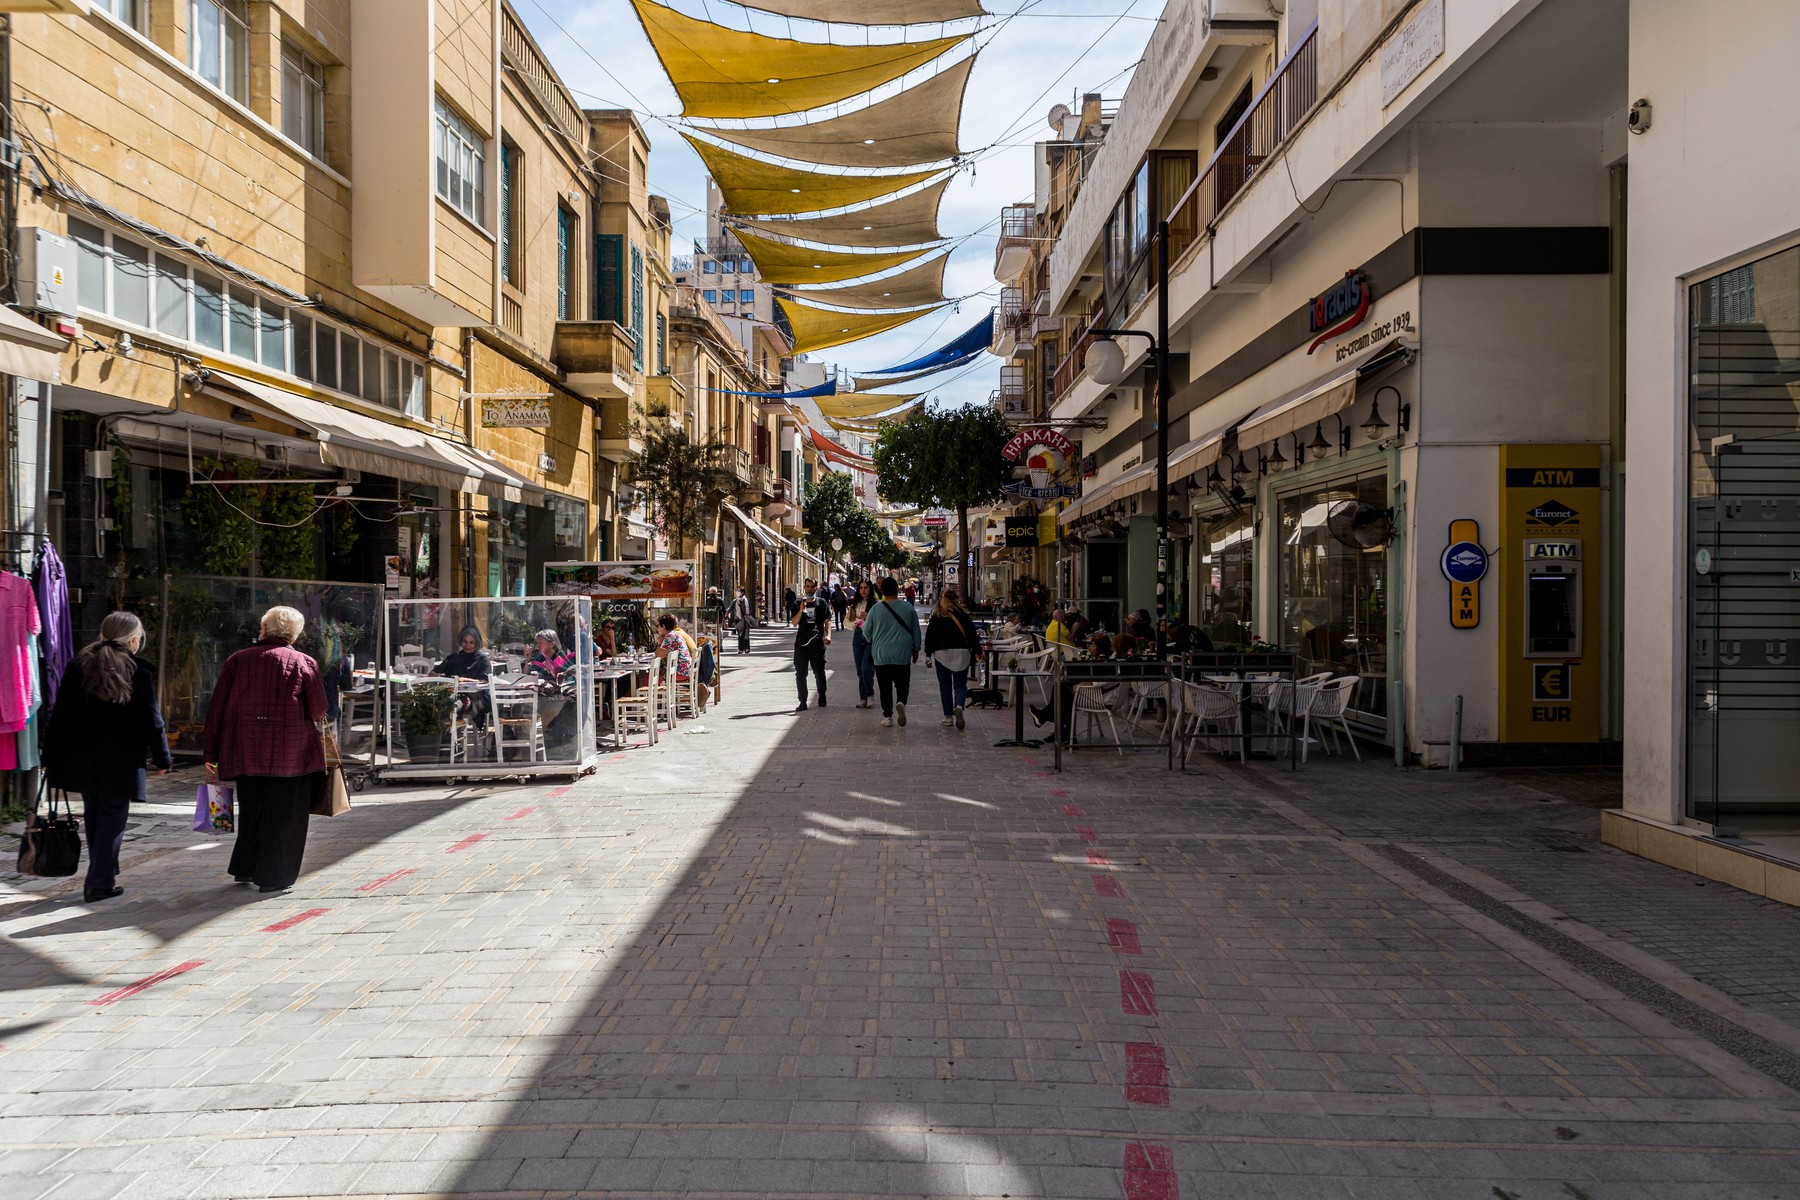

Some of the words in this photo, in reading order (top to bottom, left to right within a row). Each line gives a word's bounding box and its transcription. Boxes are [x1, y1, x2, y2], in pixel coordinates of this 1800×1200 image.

[1336, 333, 1370, 362] ice-cream
[1371, 322, 1391, 344] since
[1393, 311, 1410, 333] 1939
[1006, 429, 1071, 456] ΗΡΑΚΛΗΣ
[1532, 471, 1574, 485] ATM
[1534, 508, 1571, 518] Euronet
[1007, 525, 1034, 538] epic
[1534, 544, 1577, 557] ATM
[607, 604, 636, 612] ecco
[1460, 586, 1473, 620] ATM
[1532, 706, 1571, 722] EUR
